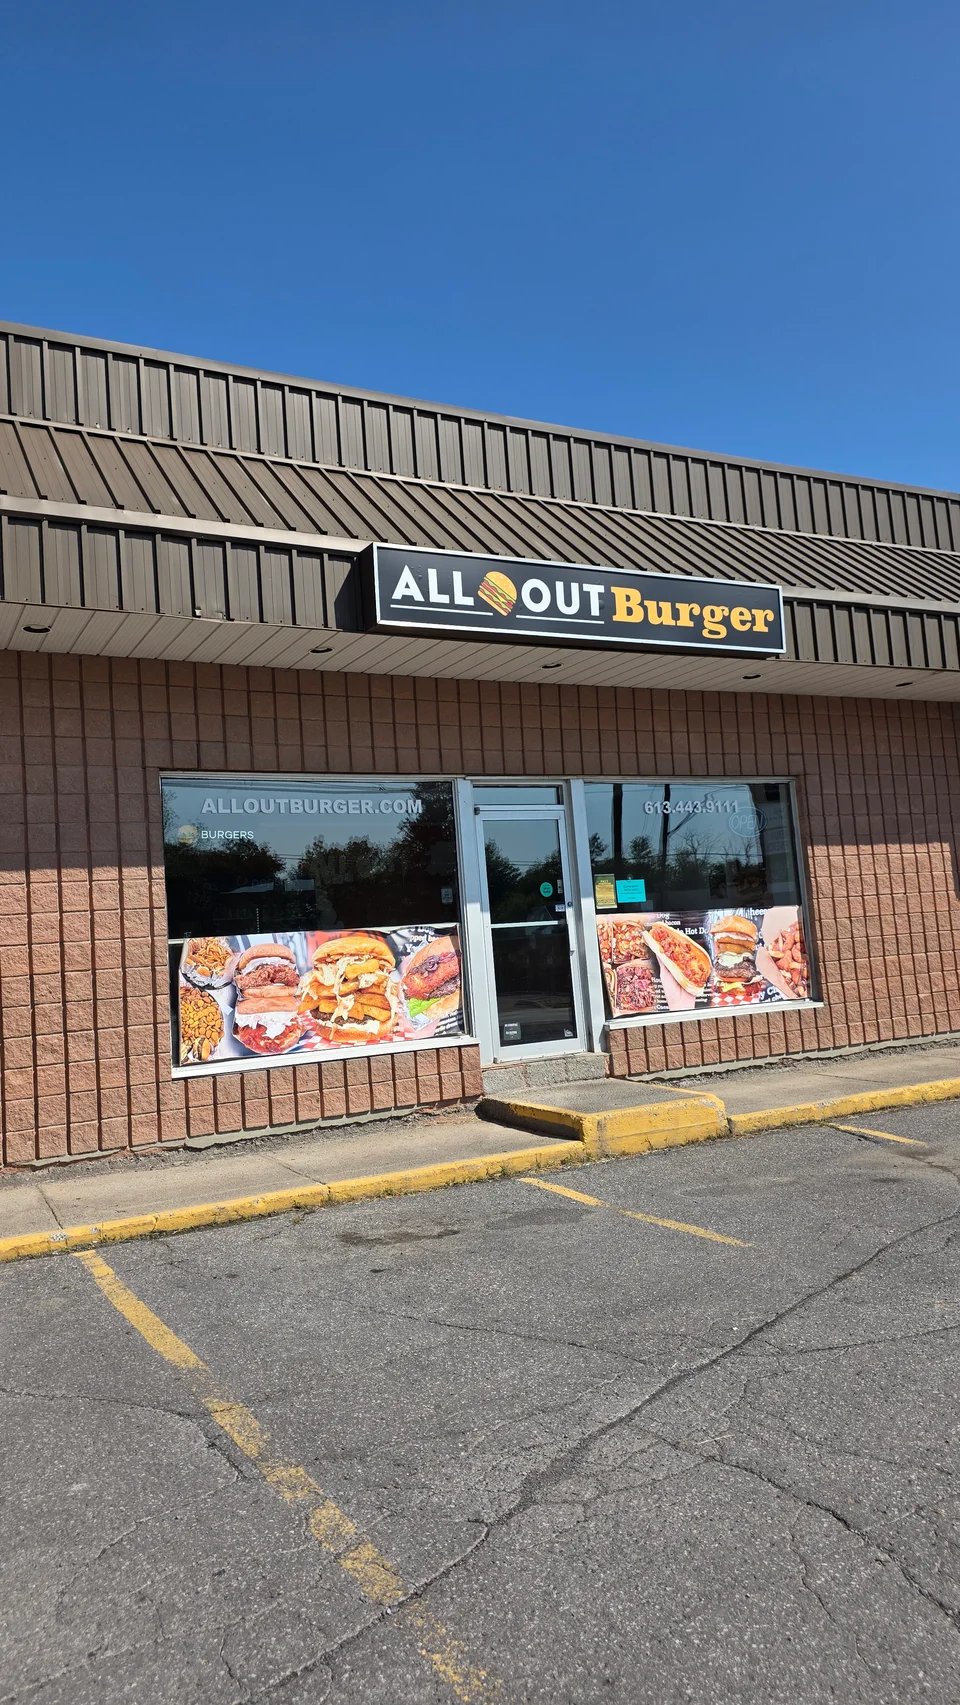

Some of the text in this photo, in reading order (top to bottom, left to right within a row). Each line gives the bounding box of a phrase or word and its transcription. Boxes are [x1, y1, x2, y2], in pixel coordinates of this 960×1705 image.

[391, 564, 774, 639] ALL OUT Burger
[202, 798, 423, 814] ALLOUTBURGER.COM
[644, 800, 738, 814] 613.443.9111
[731, 815, 763, 830] OPEN
[201, 830, 254, 839] BURGERS
[685, 927, 698, 935] Hot
